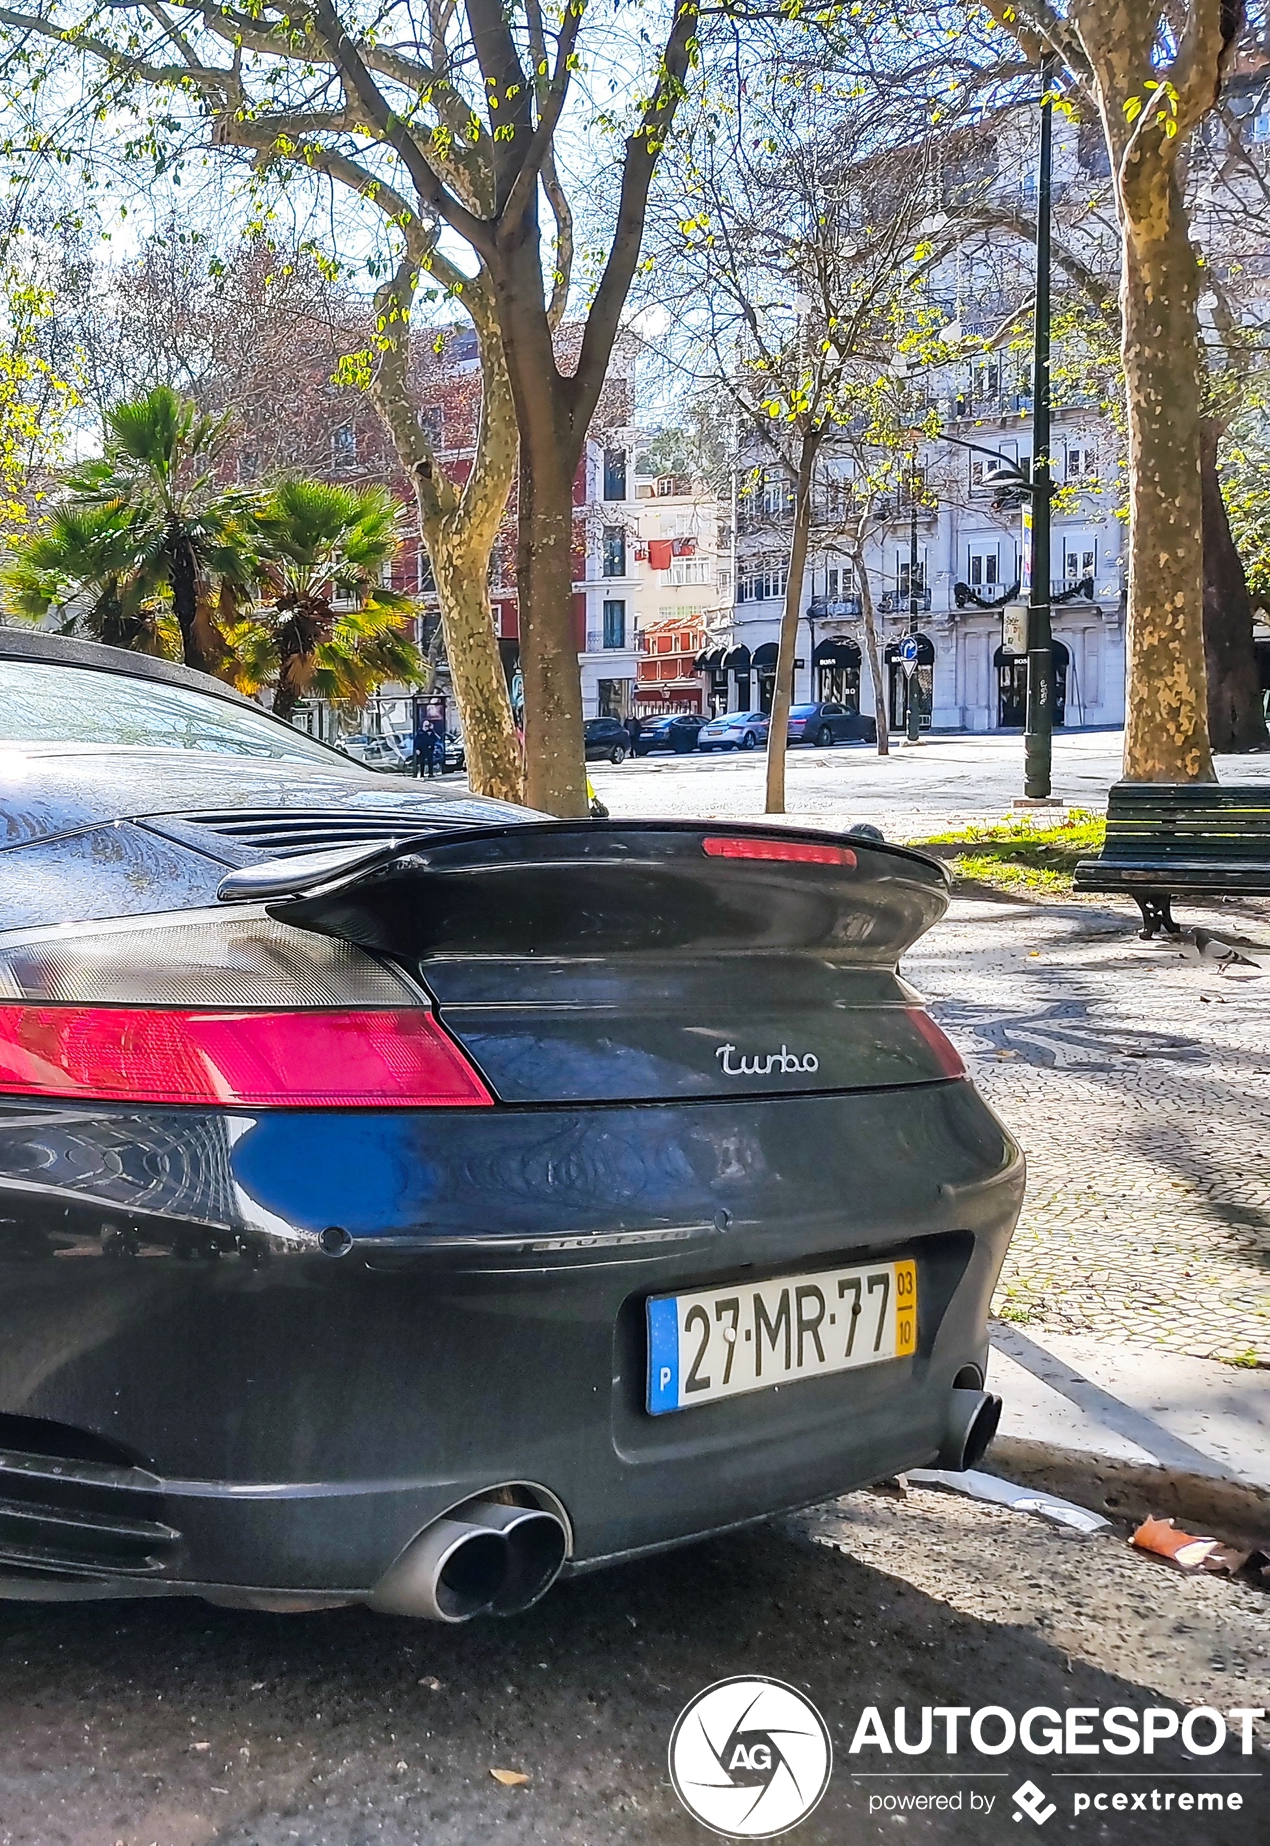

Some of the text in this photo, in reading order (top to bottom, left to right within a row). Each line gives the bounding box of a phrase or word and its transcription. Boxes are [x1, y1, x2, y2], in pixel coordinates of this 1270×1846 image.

[897, 1271, 913, 1296] 03
[899, 1320, 912, 1345] 10
[660, 1366, 672, 1392] P
